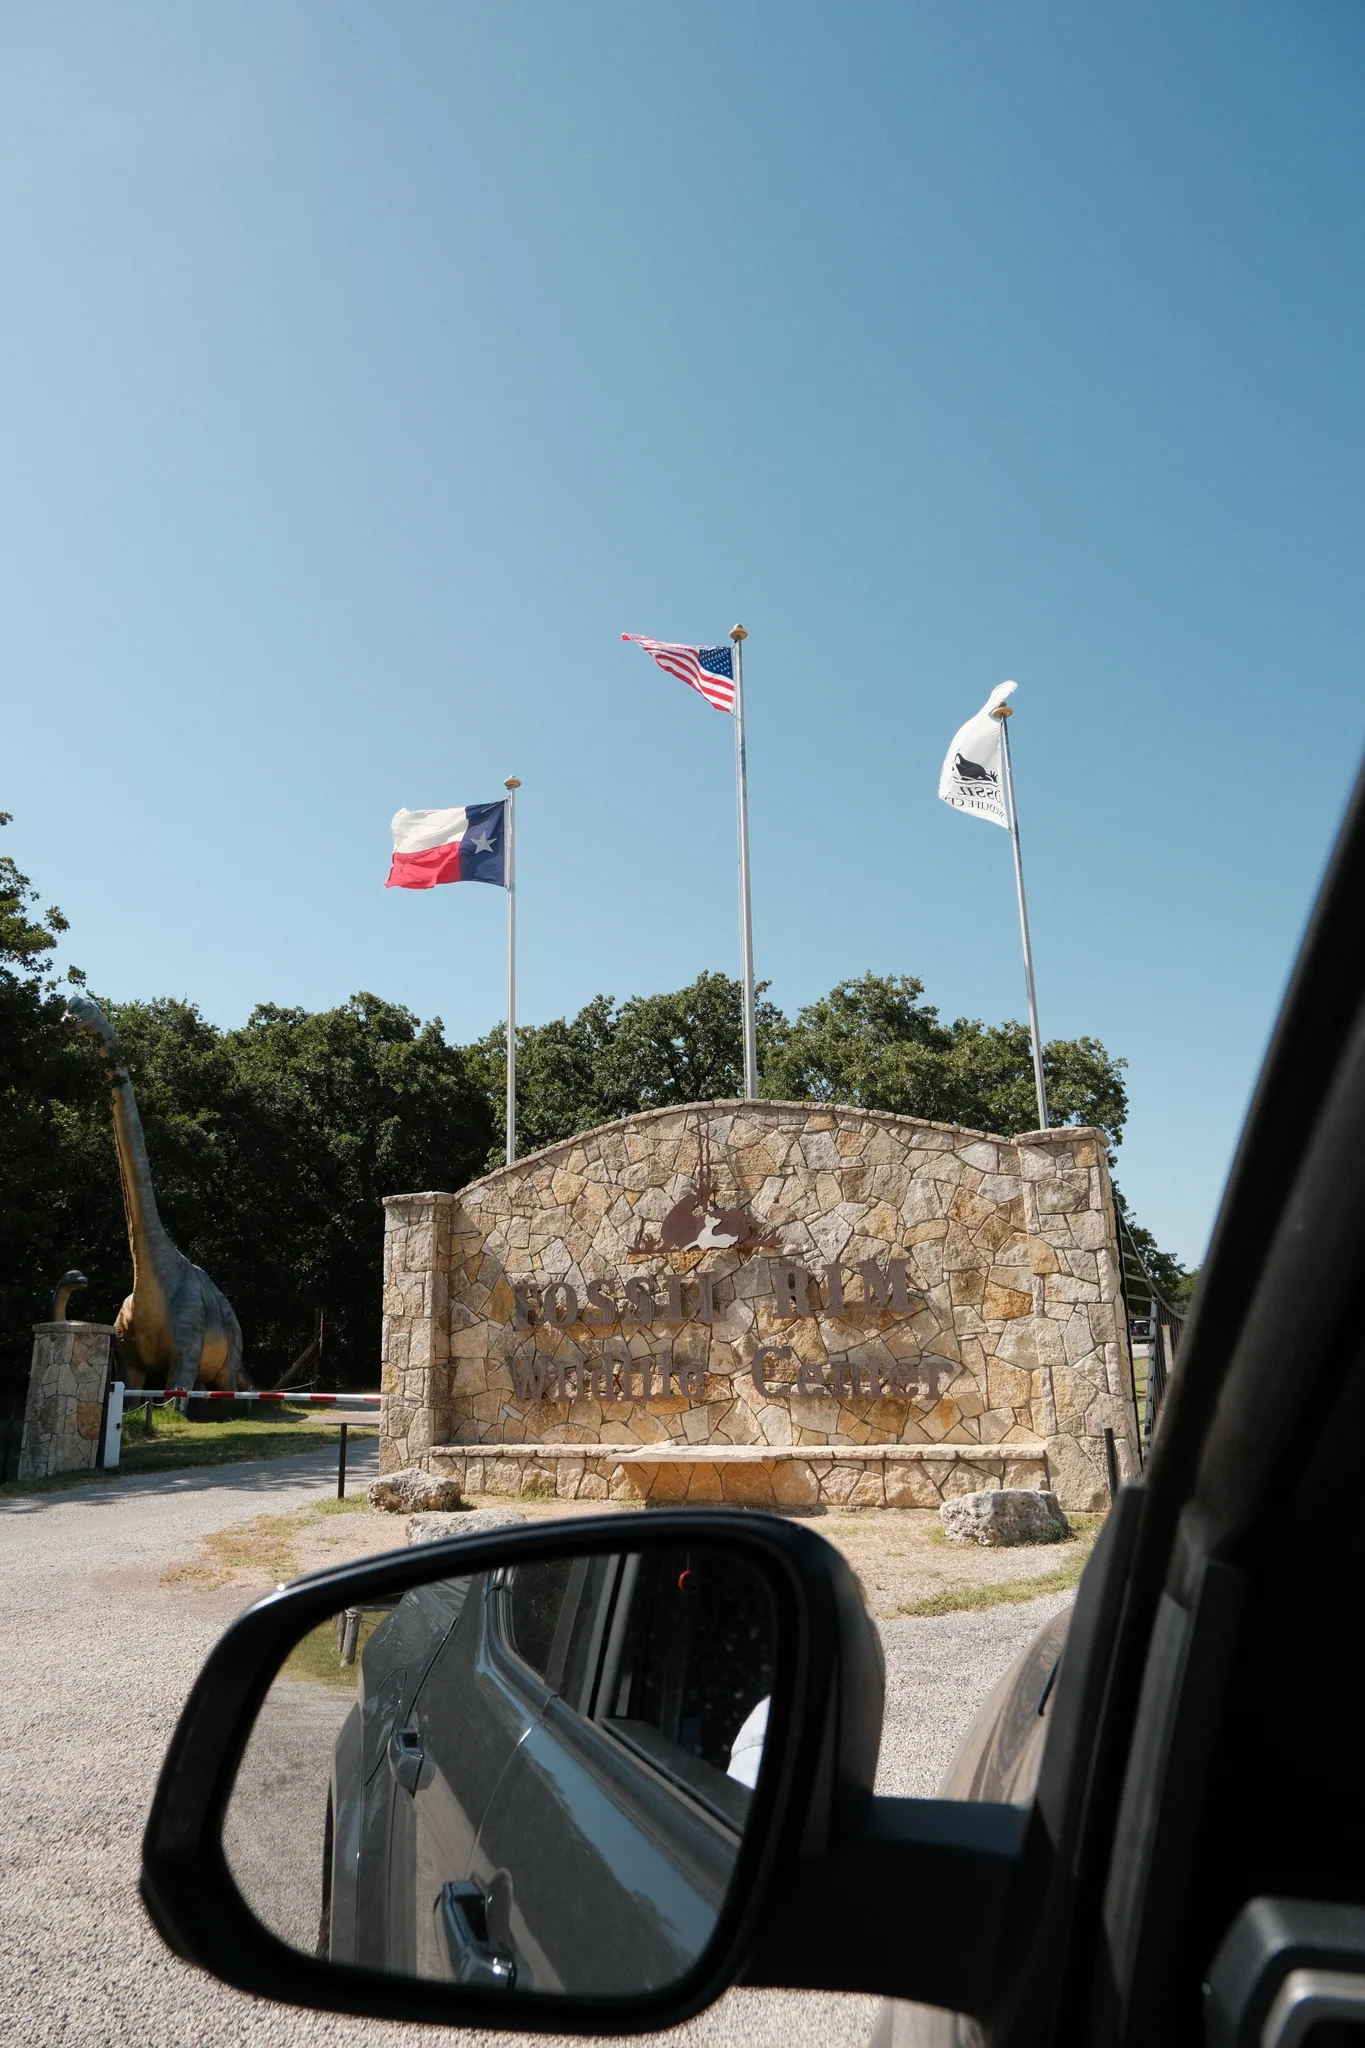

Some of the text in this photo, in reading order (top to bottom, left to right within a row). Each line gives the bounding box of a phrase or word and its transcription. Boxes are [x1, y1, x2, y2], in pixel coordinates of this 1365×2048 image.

[512, 1258, 915, 1331] FOSSIL RIM
[504, 1346, 955, 1402] Wildlife Center
